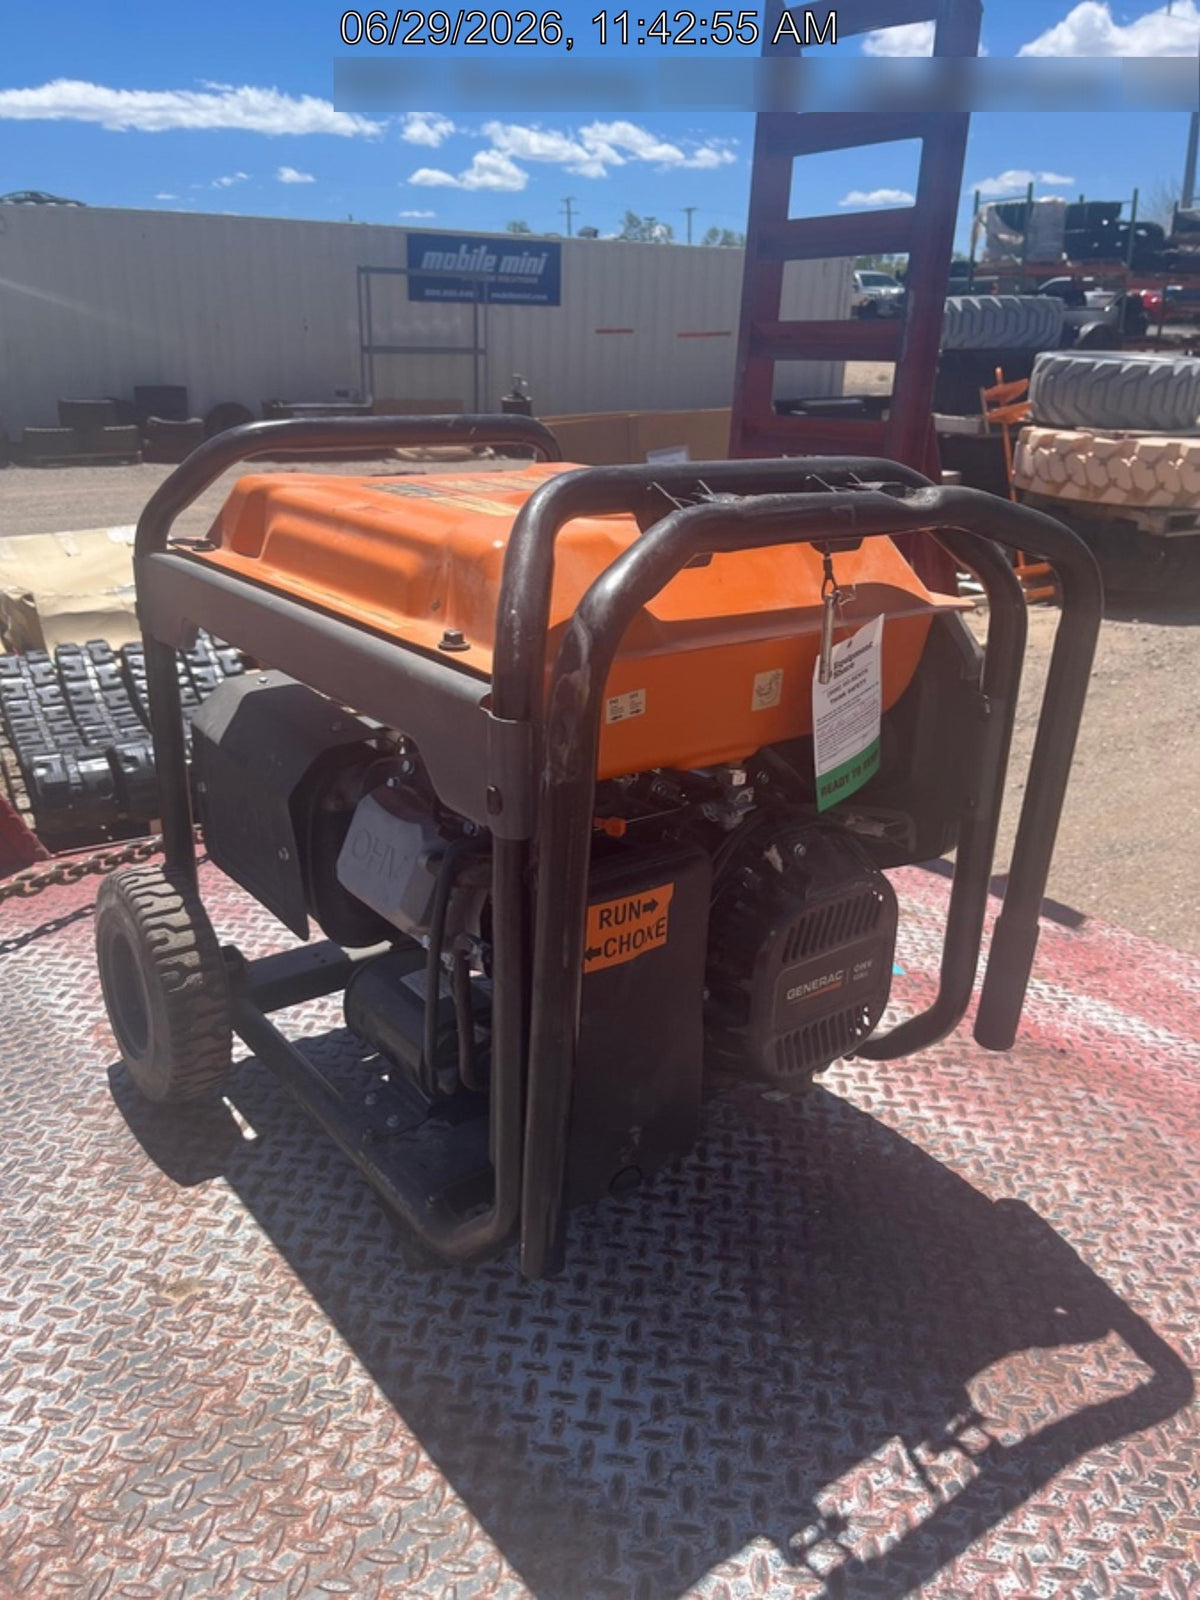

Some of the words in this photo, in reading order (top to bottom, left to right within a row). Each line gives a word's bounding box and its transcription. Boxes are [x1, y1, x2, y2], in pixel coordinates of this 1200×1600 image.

[421, 243, 498, 273] mobile
[499, 251, 549, 276] mini
[821, 773, 850, 798] READY
[851, 765, 862, 779] TO
[599, 900, 642, 931] RUN
[603, 916, 667, 959] CHOKE
[786, 969, 844, 1000] GENERAC
